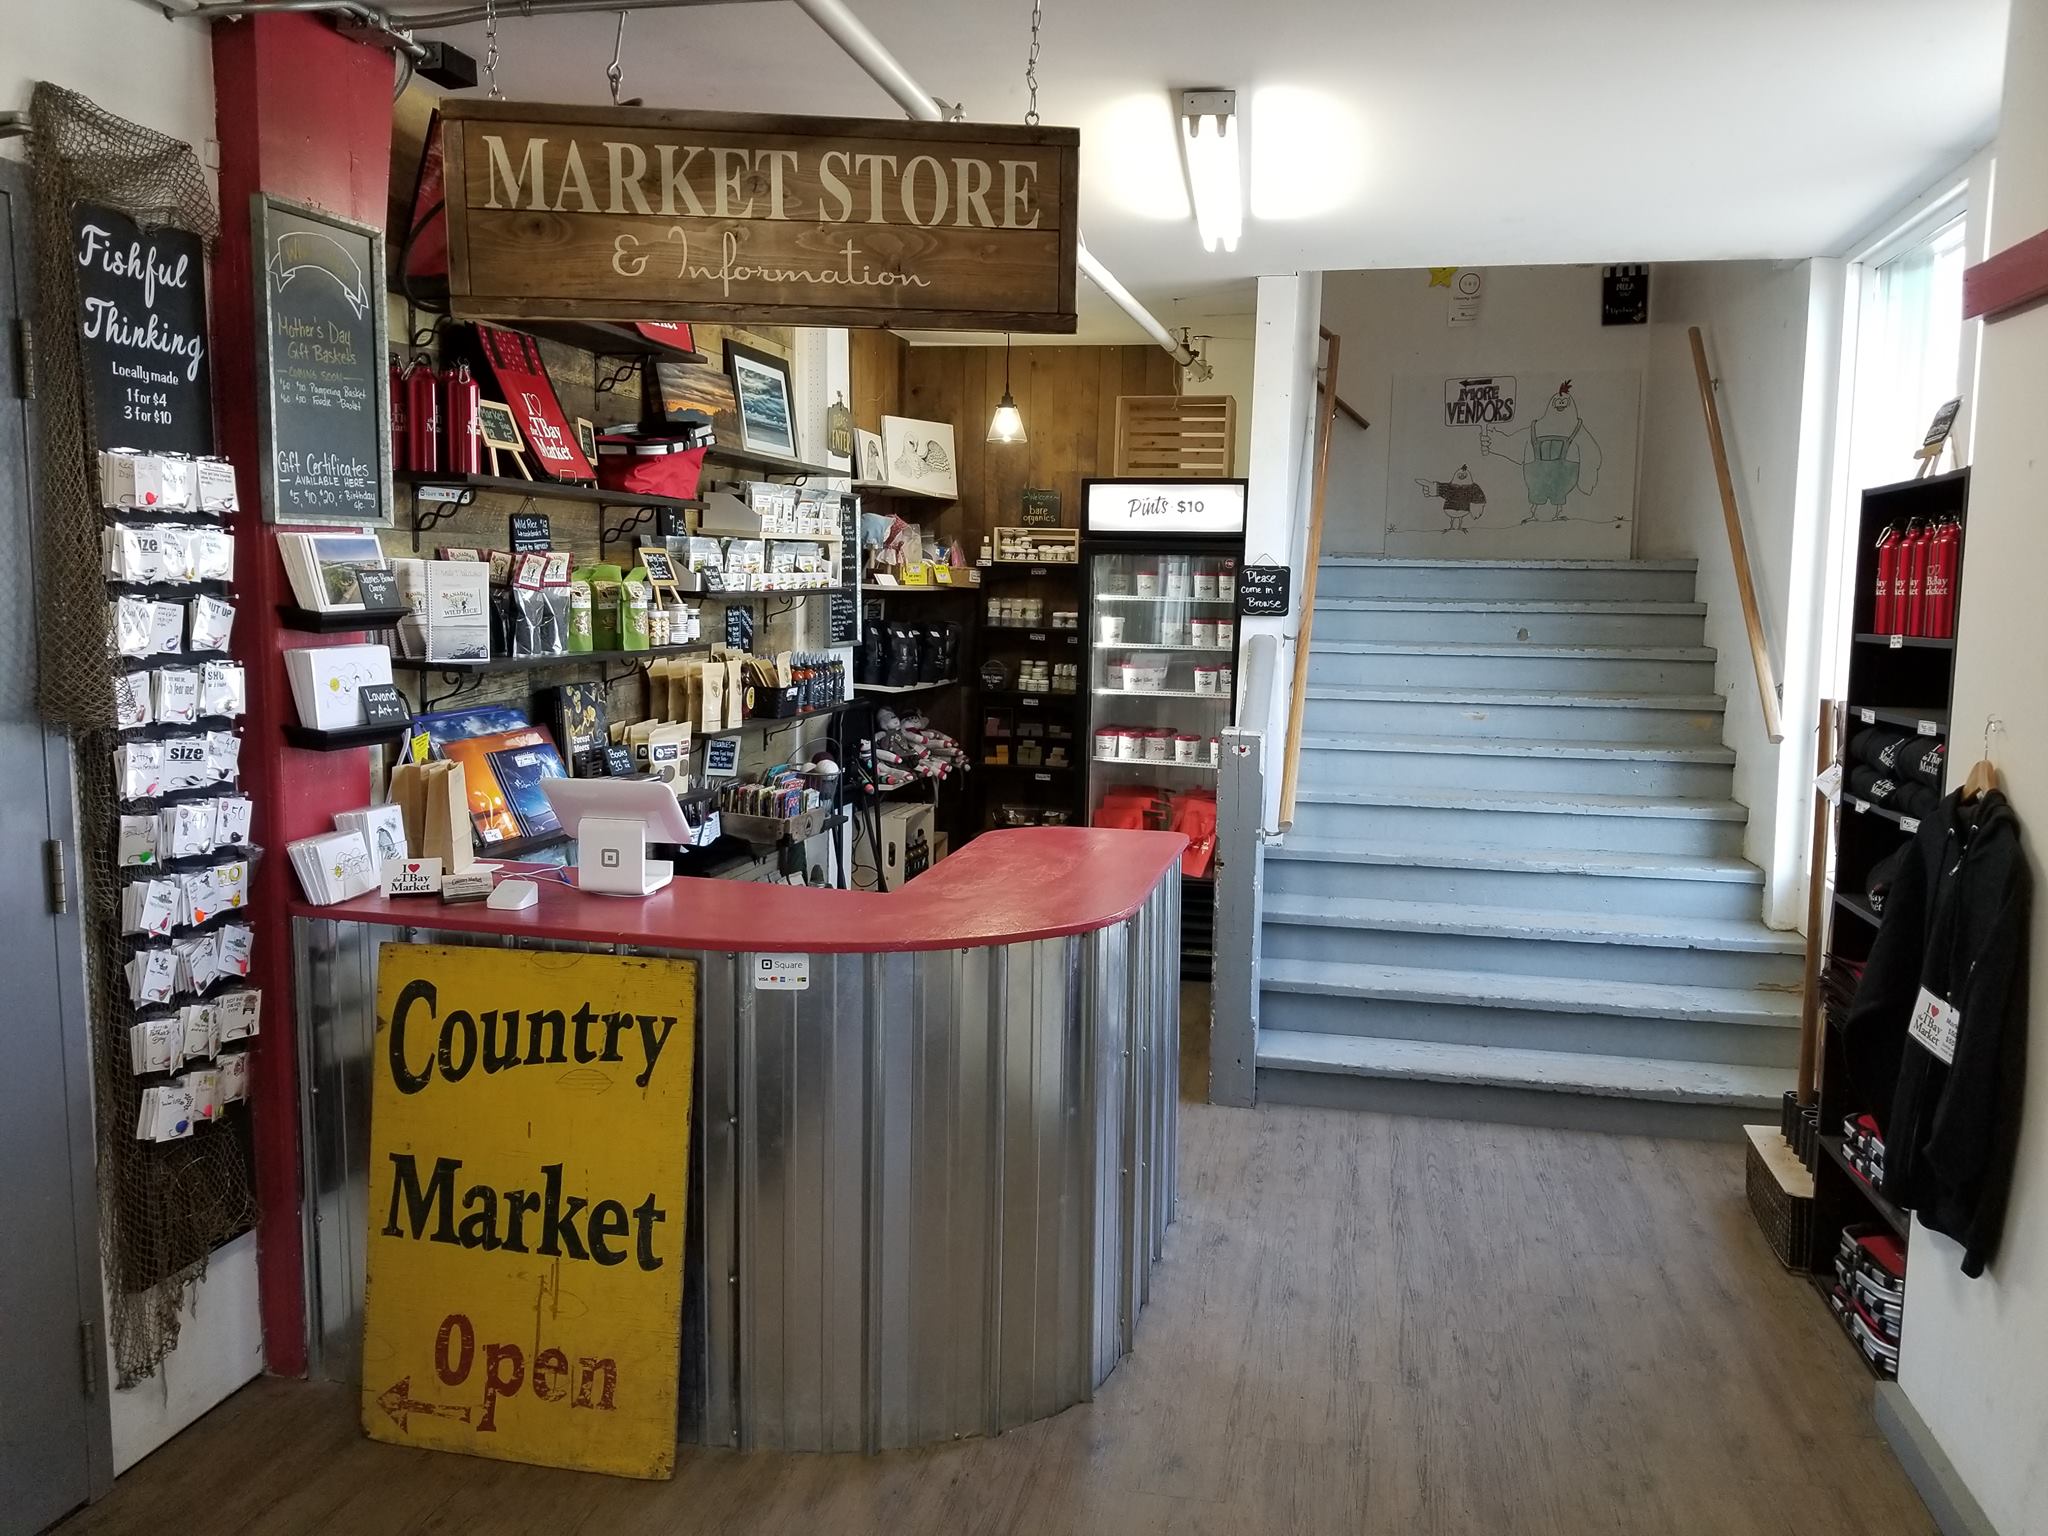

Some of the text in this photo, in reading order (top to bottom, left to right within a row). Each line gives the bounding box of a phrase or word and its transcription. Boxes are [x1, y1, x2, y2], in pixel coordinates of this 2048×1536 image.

[481, 134, 1041, 229] MARKET STORE
[79, 224, 189, 308] Fishful
[612, 225, 931, 297] & Information
[278, 312, 351, 345] Mother's Day
[83, 297, 205, 381] Thinking
[312, 344, 357, 364] Baskets
[112, 361, 179, 386] Locally made
[127, 388, 168, 407] 1 for $4
[1458, 385, 1500, 402] MORE
[124, 404, 173, 425] 3 for $10
[1447, 399, 1514, 425] VENDORS
[533, 437, 574, 460] Market
[278, 450, 370, 477] Gift Certificates
[295, 475, 365, 488] AVAILABLE HERE
[1029, 504, 1048, 515] bare
[1128, 495, 1205, 518] Pints $10
[1022, 514, 1056, 525] organics
[137, 536, 158, 551] ize
[1246, 570, 1277, 583] Please
[1241, 585, 1263, 594] come
[1265, 585, 1274, 594] in
[222, 605, 232, 618] UP
[1248, 597, 1282, 608] Browse
[170, 746, 204, 760] size
[609, 748, 628, 759] Books
[231, 806, 246, 821] 50
[217, 865, 243, 887] 50
[403, 863, 407, 873] I
[391, 881, 430, 891] Market
[400, 873, 430, 884] TBay
[774, 960, 803, 970] Square
[389, 978, 678, 1094] Country
[1913, 1018, 1941, 1046] Market
[381, 1152, 667, 1271] Market
[434, 1313, 618, 1432] Open
